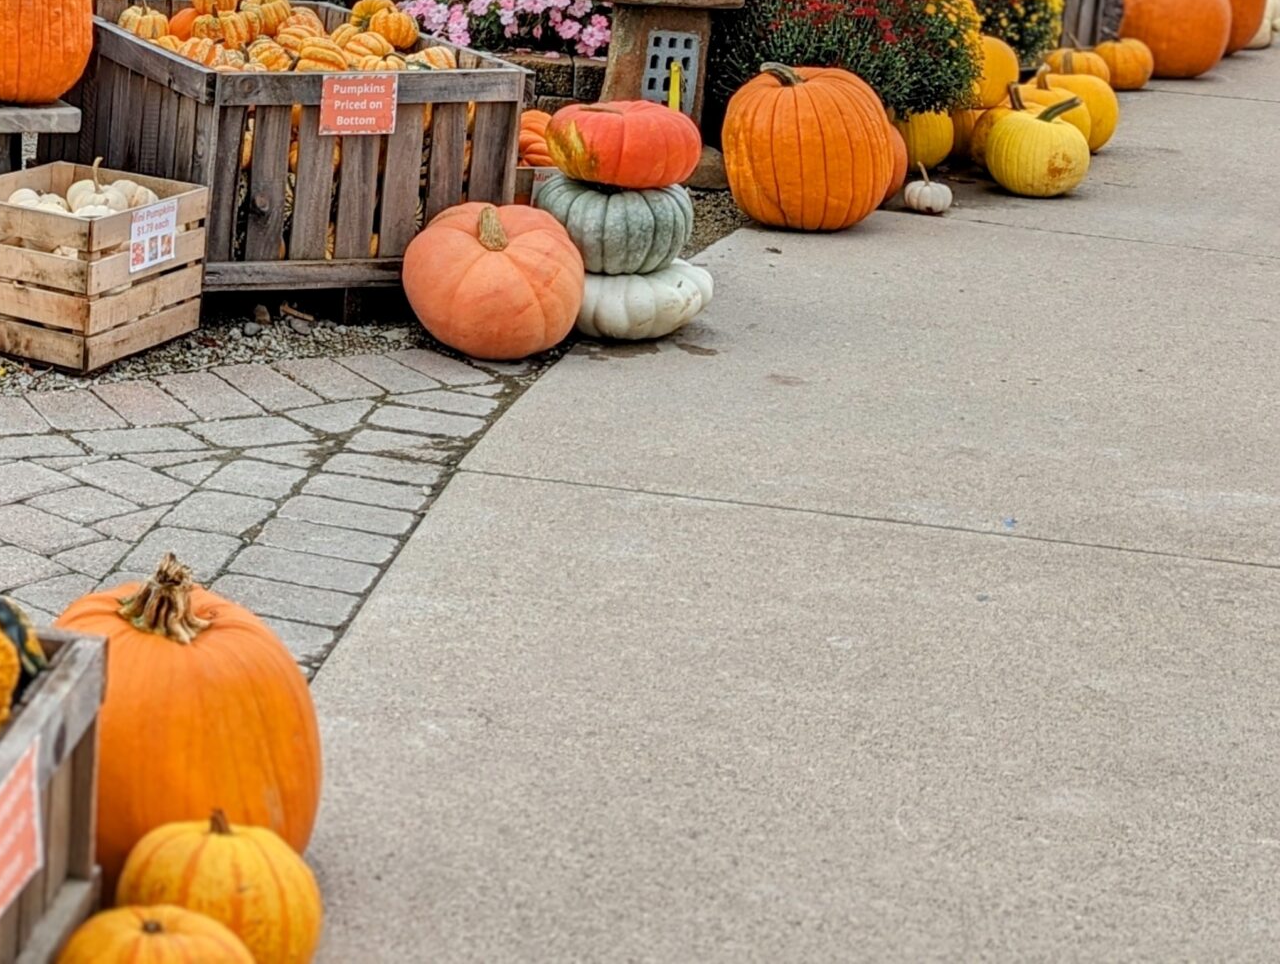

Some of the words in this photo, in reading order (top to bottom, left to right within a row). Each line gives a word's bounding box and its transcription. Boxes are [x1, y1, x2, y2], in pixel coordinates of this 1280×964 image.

[332, 83, 386, 97] Pumpkins
[334, 99, 367, 110] Priced
[369, 101, 383, 109] on
[336, 116, 376, 126] Bottom
